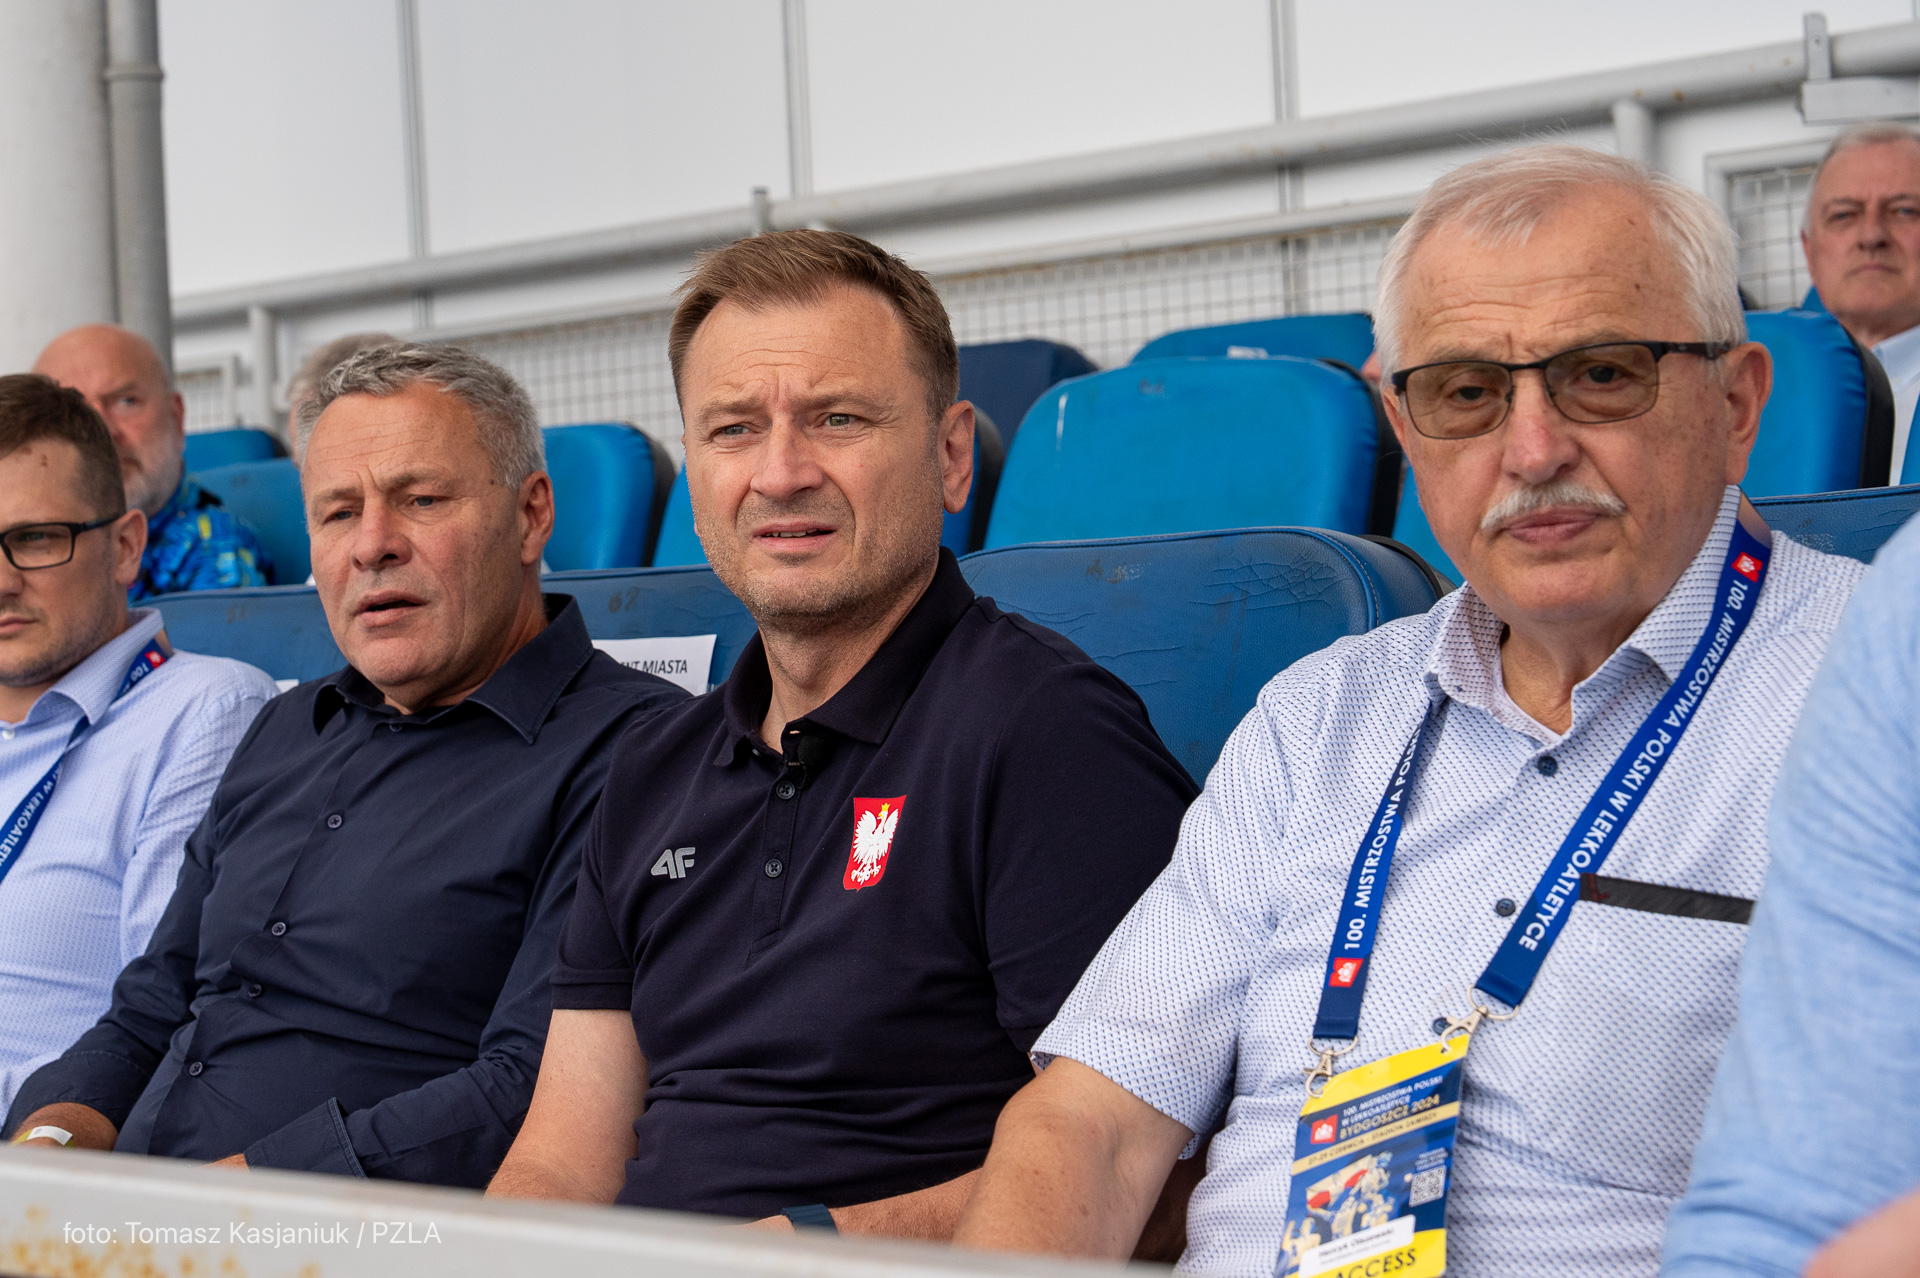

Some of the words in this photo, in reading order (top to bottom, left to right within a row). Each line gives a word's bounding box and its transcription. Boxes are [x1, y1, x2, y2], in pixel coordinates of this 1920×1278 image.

[1726, 579, 1748, 611] 100.
[642, 659, 688, 675] MIASTA
[1663, 612, 1736, 728] MISTRZOSTWA
[1621, 728, 1673, 791] POLSKI
[43, 780, 54, 795] W
[1608, 790, 1633, 813] W
[650, 846, 696, 880] 4F
[1354, 788, 1403, 909] MISTRZOSTWA
[1518, 809, 1619, 952] LEKKOATLETYCE
[1344, 913, 1367, 951] 100.
[1339, 1104, 1409, 1140] BYDGOSZCZ
[1410, 1093, 1440, 1113] 2024
